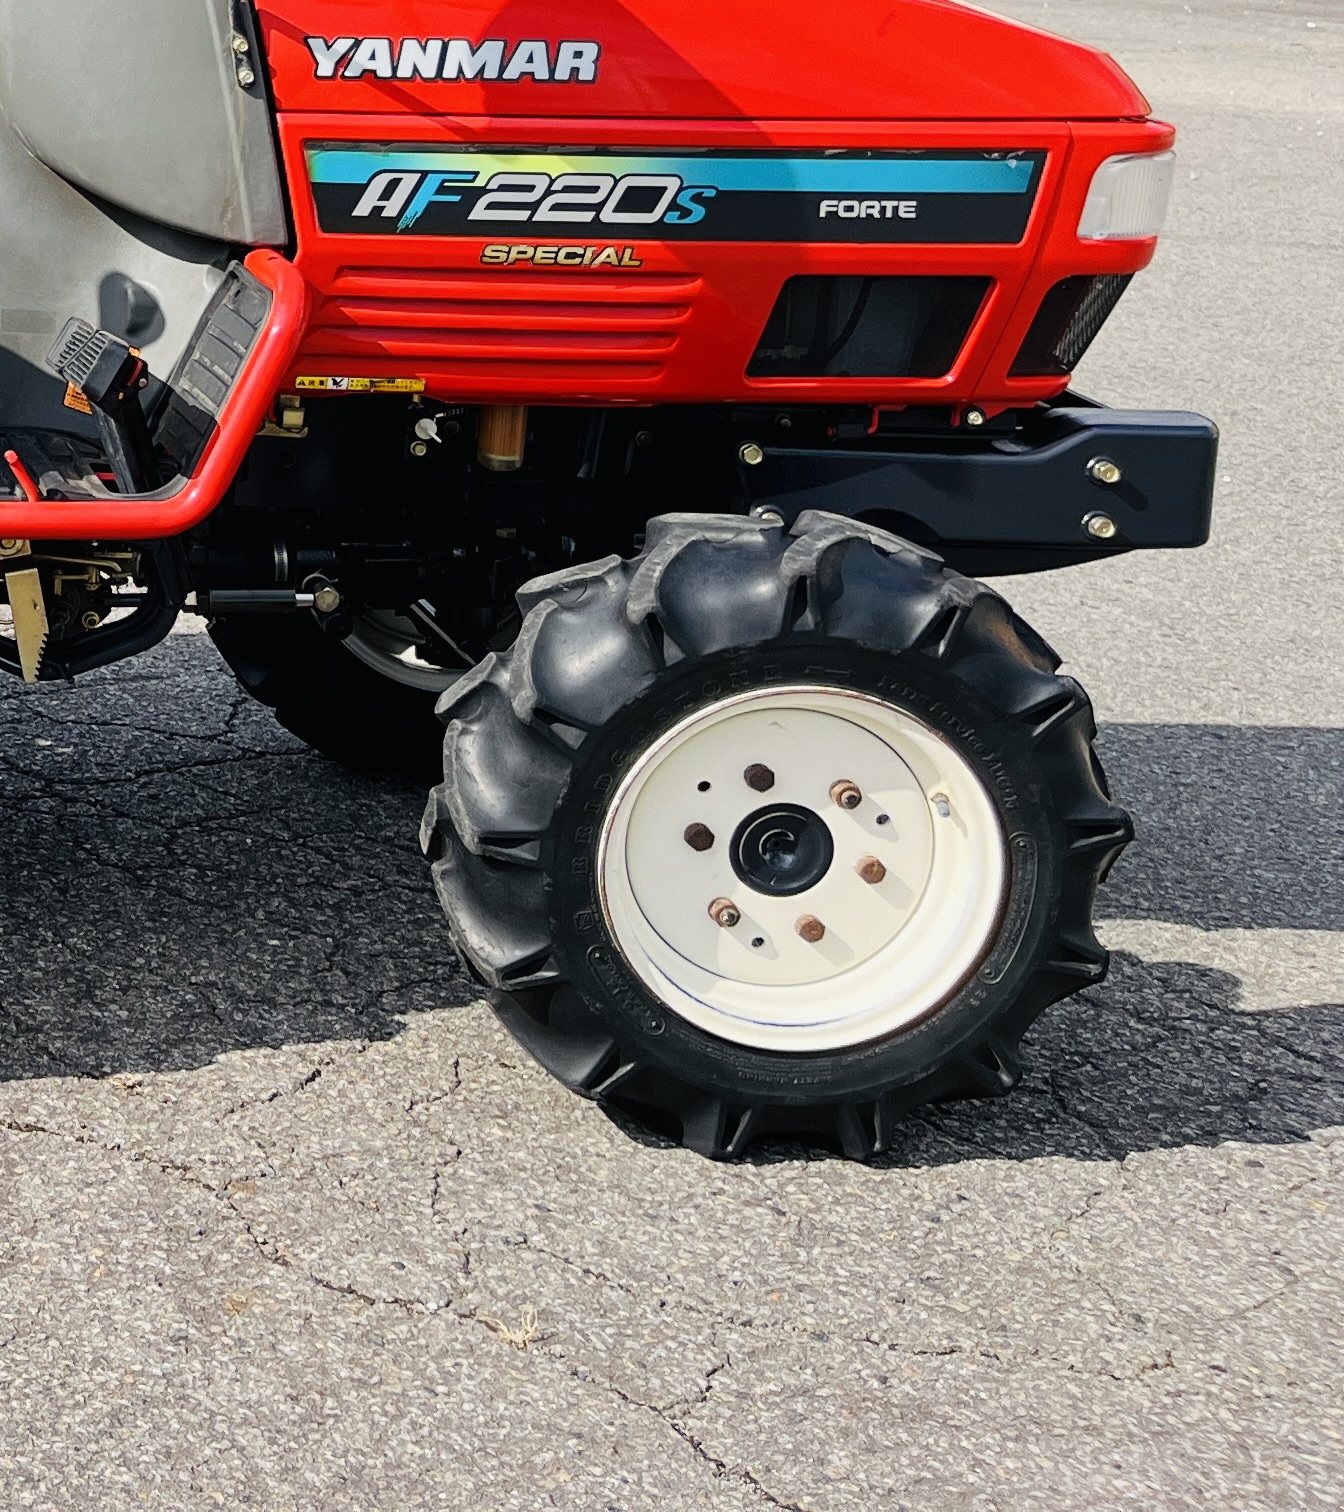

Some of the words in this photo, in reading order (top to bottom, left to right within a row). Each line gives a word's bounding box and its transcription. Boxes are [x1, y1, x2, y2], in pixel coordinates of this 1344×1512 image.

[305, 36, 602, 82] YANMAR
[819, 199, 917, 219] FORTE
[479, 243, 644, 268] SPECIAL
